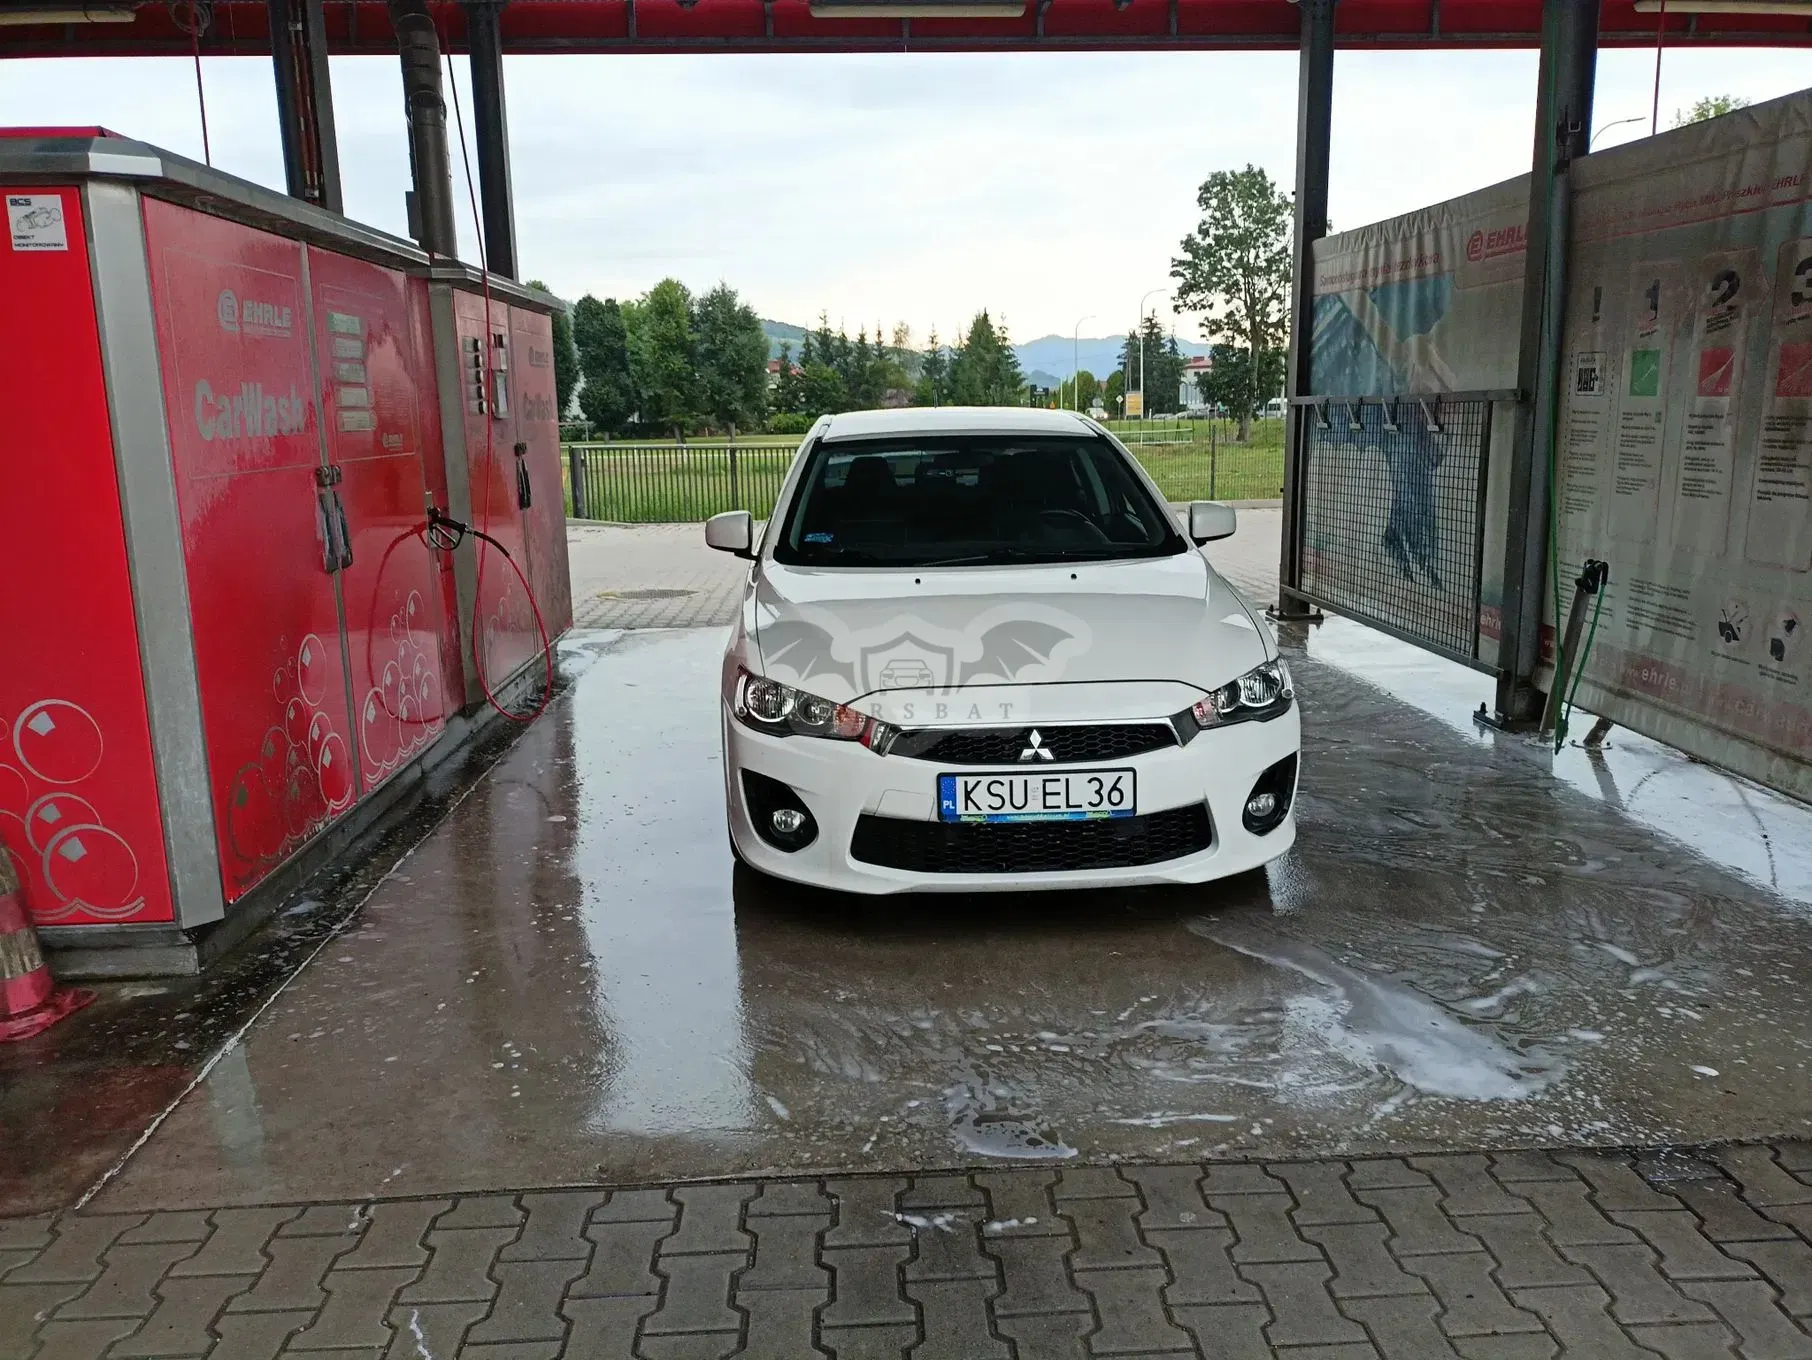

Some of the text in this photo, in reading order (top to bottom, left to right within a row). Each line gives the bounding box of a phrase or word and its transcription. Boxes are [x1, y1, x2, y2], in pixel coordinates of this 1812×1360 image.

[10, 198, 31, 207] BCS
[1487, 224, 1526, 249] EHRL
[1711, 269, 1741, 311] 2
[243, 300, 292, 328] EHRLE
[195, 379, 304, 441] CarWash
[943, 800, 955, 809] PL
[963, 775, 1124, 811] KSU EL36
